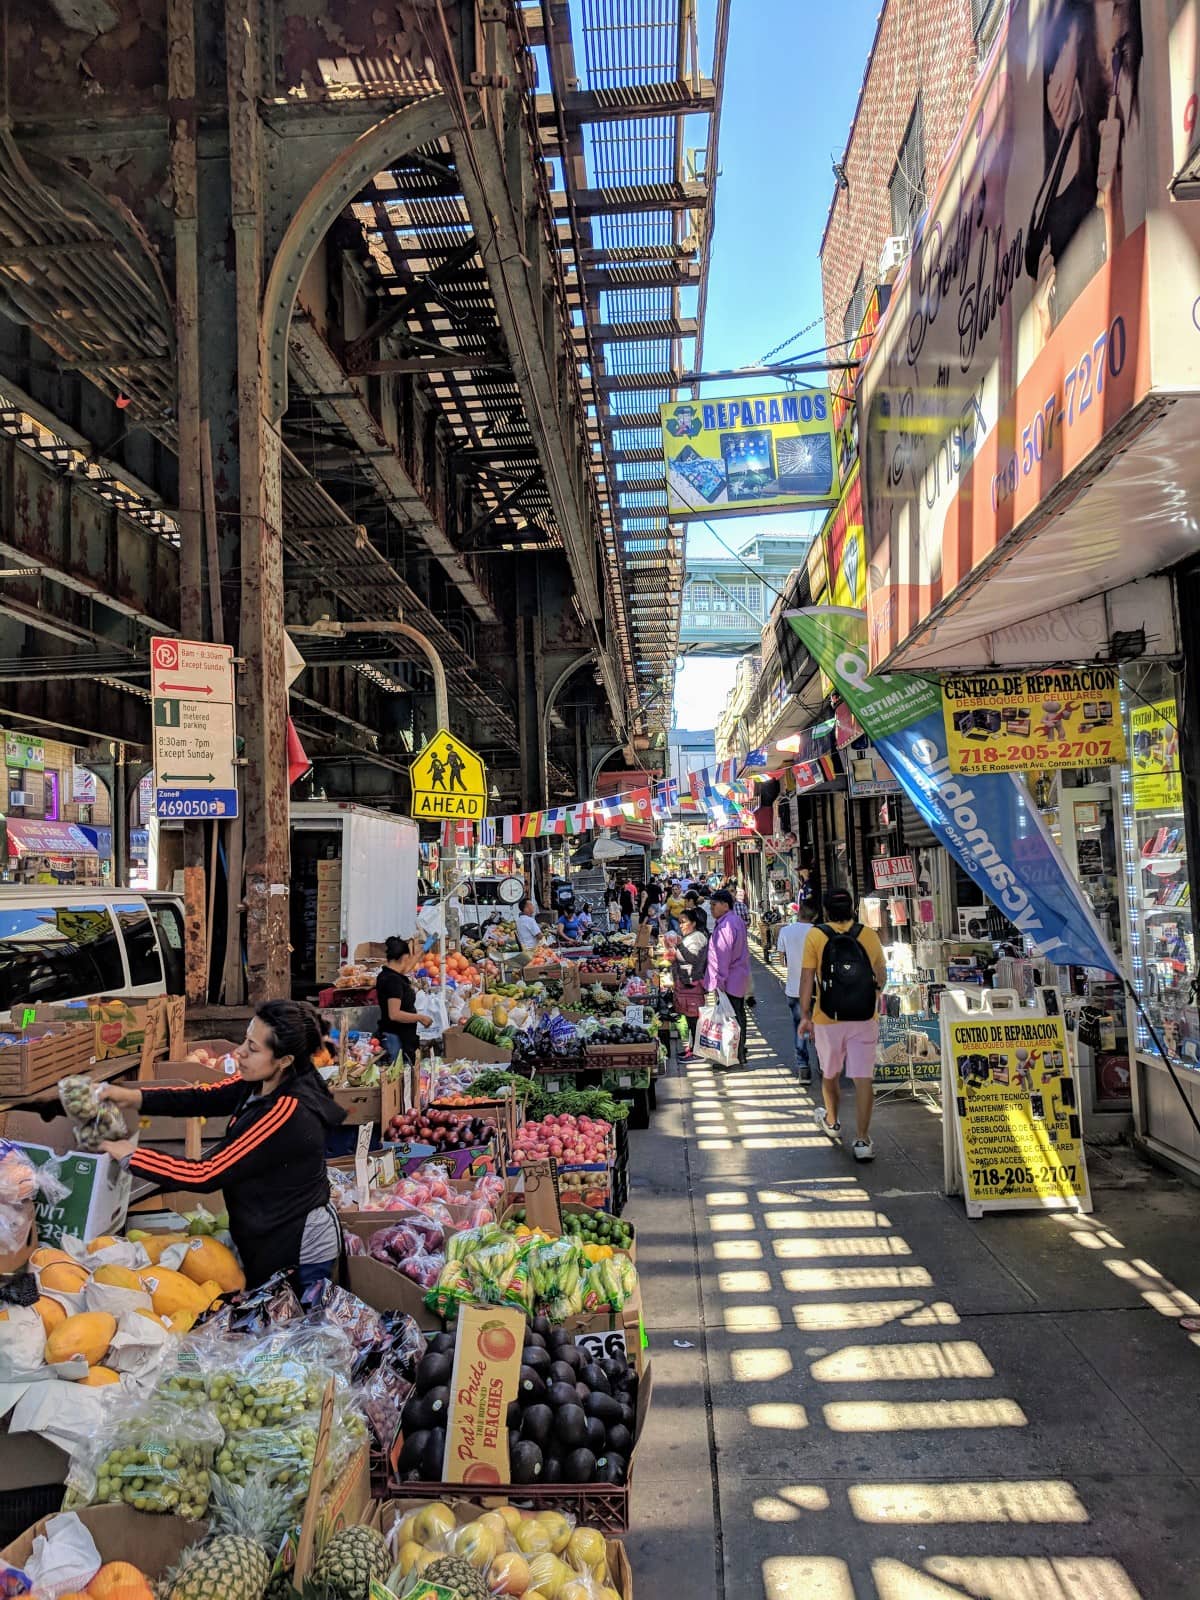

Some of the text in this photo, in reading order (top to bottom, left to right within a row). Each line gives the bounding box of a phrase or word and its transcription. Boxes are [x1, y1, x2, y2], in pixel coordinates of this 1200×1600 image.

[957, 224, 1024, 374] Salon
[1022, 315, 1126, 476] 507-7270
[702, 394, 828, 431] REPARAMOS
[181, 648, 195, 657] 8am
[181, 660, 225, 672] Except Sunday
[944, 670, 1115, 700] CENTRO DE REPARACION
[956, 690, 1103, 708] DESBLOQUEO DE CELULARES
[162, 702, 198, 725] 1 hour
[183, 712, 210, 721] metered
[183, 721, 207, 731] parking
[158, 736, 187, 748] 8:30am
[194, 738, 210, 749] 7pm
[159, 749, 214, 761] Except Sunday
[959, 740, 1112, 764] 718-205-2707
[960, 765, 980, 773] 96-15
[982, 764, 988, 772] E
[989, 762, 1028, 772] Roosevelt
[1048, 760, 1076, 768] Corona
[158, 790, 180, 798] Zone#
[158, 800, 208, 816] 469050
[421, 796, 478, 815] AHEAD
[874, 857, 913, 876] FOR SALE
[955, 1024, 1058, 1043] CENTRO DE REPARACION
[963, 1040, 1052, 1050] DESBLOQUEO DE CELULARES
[967, 1093, 998, 1103] SOPORTE
[969, 1103, 1023, 1113] MANTENIMIENTO
[971, 1121, 1069, 1134] DESBLOQUEO DE CELULARES
[978, 1134, 1034, 1144] COMPUTADORAS
[974, 1145, 1022, 1155] ACTIVACIONES
[1024, 1145, 1033, 1153] DE
[1000, 1155, 1044, 1165] ACCESORIOS
[972, 1165, 1077, 1186] 718-205-2707
[457, 1360, 487, 1461] Pat's Pride
[483, 1378, 504, 1449] PEACHES
